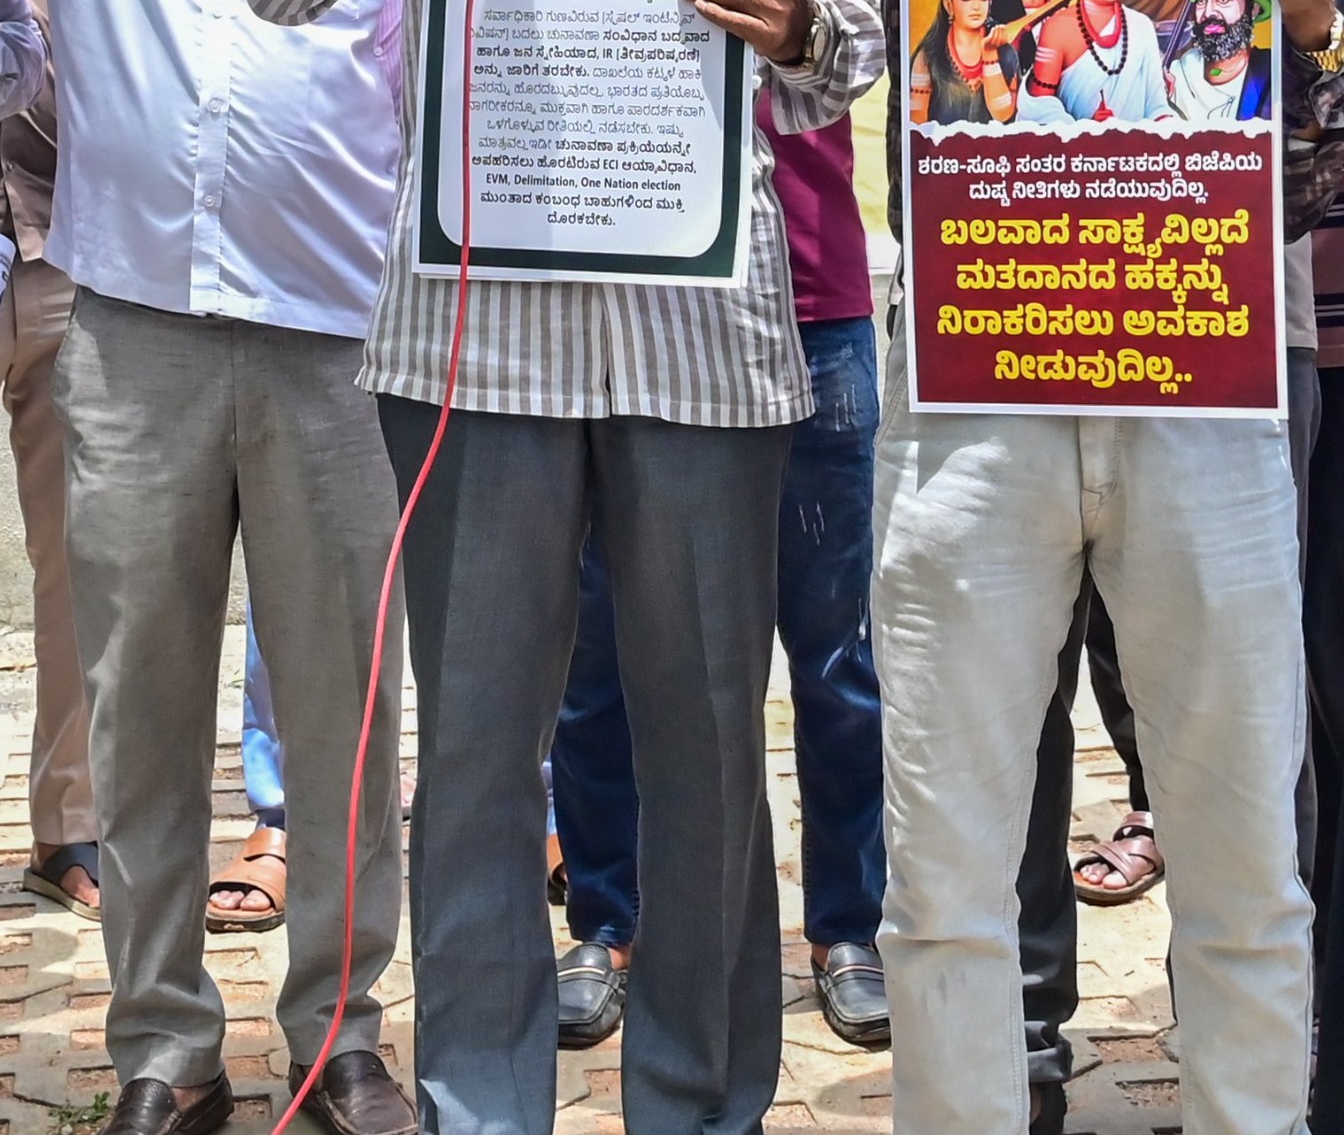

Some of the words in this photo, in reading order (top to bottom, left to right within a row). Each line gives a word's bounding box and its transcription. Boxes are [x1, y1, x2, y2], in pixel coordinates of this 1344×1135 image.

[917, 154, 1011, 177] ಶರಣ-ಸೂಫಿ
[1015, 152, 1066, 173] ಸಂತರ
[1069, 151, 1182, 176] ಕರ್ನಾಟಕದಲ್ಲಿ
[1184, 150, 1262, 171] ಬಿಜೆಪಿಯ
[485, 172, 511, 186] EVM,
[513, 173, 578, 189] Delimitation,
[579, 176, 601, 188] One
[603, 176, 639, 189] Nation
[640, 178, 681, 191] election
[968, 179, 1011, 206] ದುಷ್ಟ
[1011, 178, 1081, 199] ನೀತಿಗಳು
[1084, 177, 1209, 204] ನಡೆಯುವುದಿಲ್ಲ.
[479, 189, 532, 204] ಮುಂತಾದ
[583, 194, 653, 209] ಬಾಹುಗಳಿಂದ
[655, 196, 685, 213] ಮುಕ್ತಿ
[546, 208, 616, 226] ದೊರಕಬೇಕು.
[940, 212, 1070, 244] ಬಲವಾದ
[1078, 208, 1249, 257] ಸಾಕ್ಷ್ಯವಿಲ್ಲದೆ
[956, 257, 1116, 289] ಮತದಾನದ
[1124, 257, 1229, 304] ಹಕ್ಕನ್ನು
[936, 301, 1114, 335] ನಿರಾಕರಿಸಲು
[1122, 303, 1249, 337] ಅವಕಾಶ
[994, 347, 1192, 393] ನೀಡುವುದಿಲ್ಲ..
